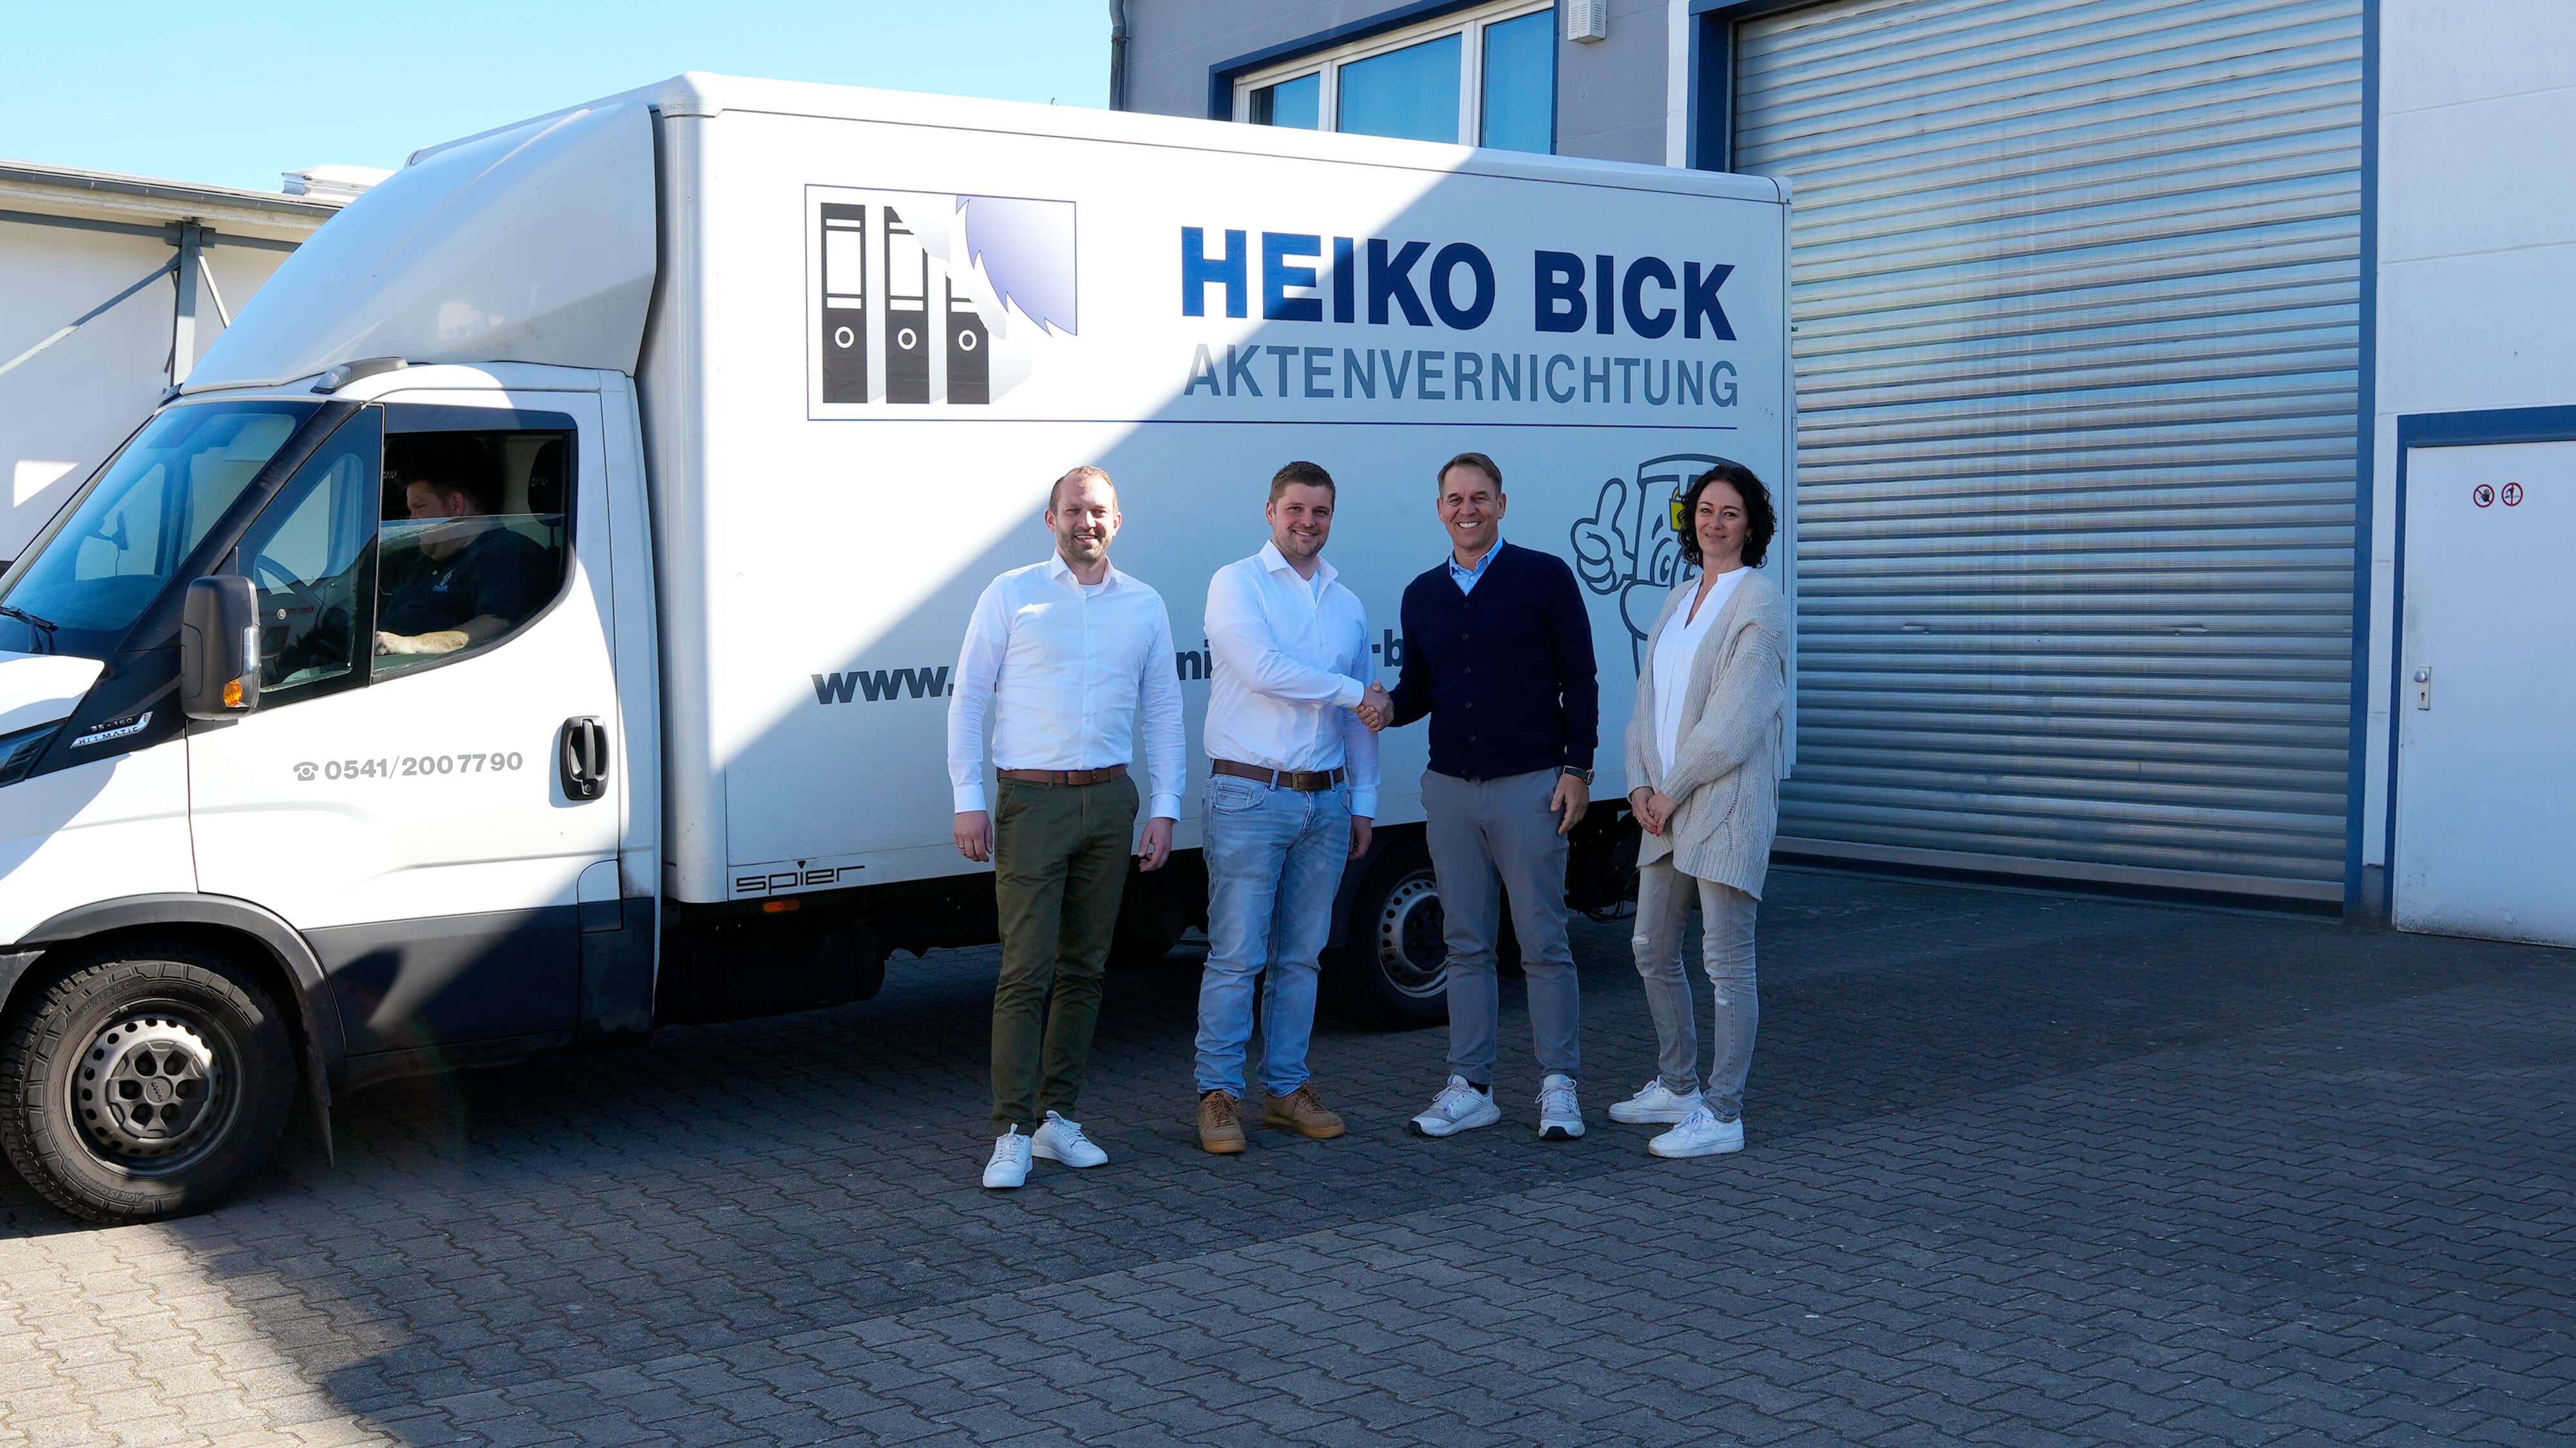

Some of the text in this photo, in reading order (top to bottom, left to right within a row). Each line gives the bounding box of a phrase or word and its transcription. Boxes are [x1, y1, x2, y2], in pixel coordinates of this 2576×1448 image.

[1181, 226, 1737, 341] HEIKO BICK
[1184, 343, 1738, 407] AKTENVERNICHTUNG
[736, 860, 865, 895] spier
